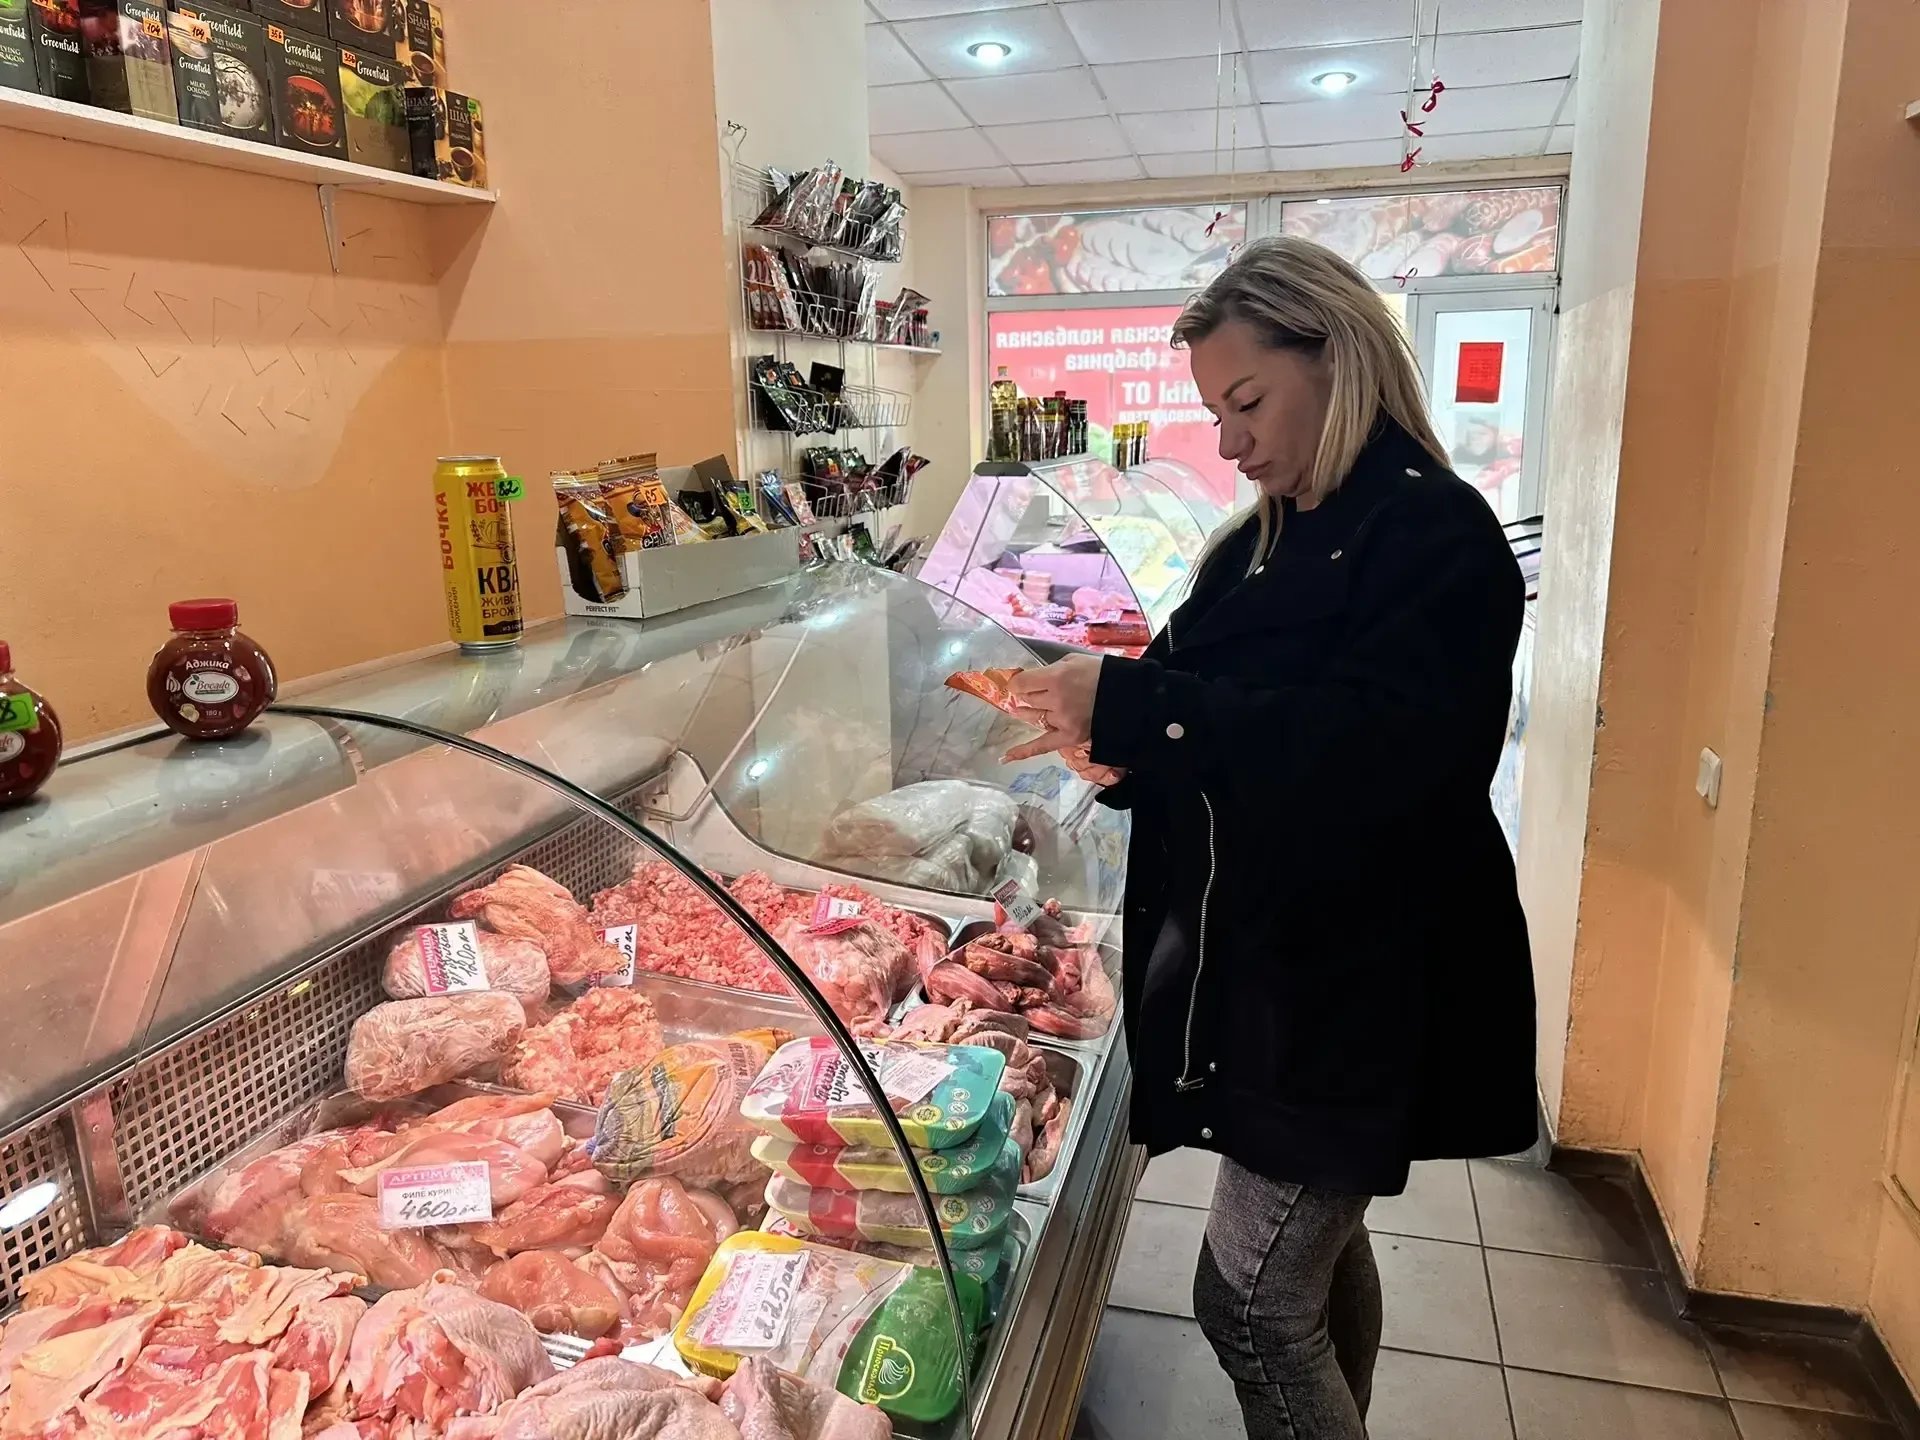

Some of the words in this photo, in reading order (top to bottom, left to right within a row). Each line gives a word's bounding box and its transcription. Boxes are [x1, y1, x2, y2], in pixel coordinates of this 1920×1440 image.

[125, 2, 160, 21] Greenfield
[41, 33, 80, 54] Greenfield
[284, 38, 323, 62] Greenfield
[179, 56, 212, 75] Greenfield
[357, 60, 391, 82] Greenfield
[466, 481, 497, 498] ЖЕ
[645, 488, 657, 503] 65
[436, 491, 454, 570] БОЧКА
[585, 605, 608, 613] PERFECT
[185, 659, 230, 671] Аджика
[196, 679, 231, 691] Bocado
[401, 1191, 426, 1199] ФИЛЕ
